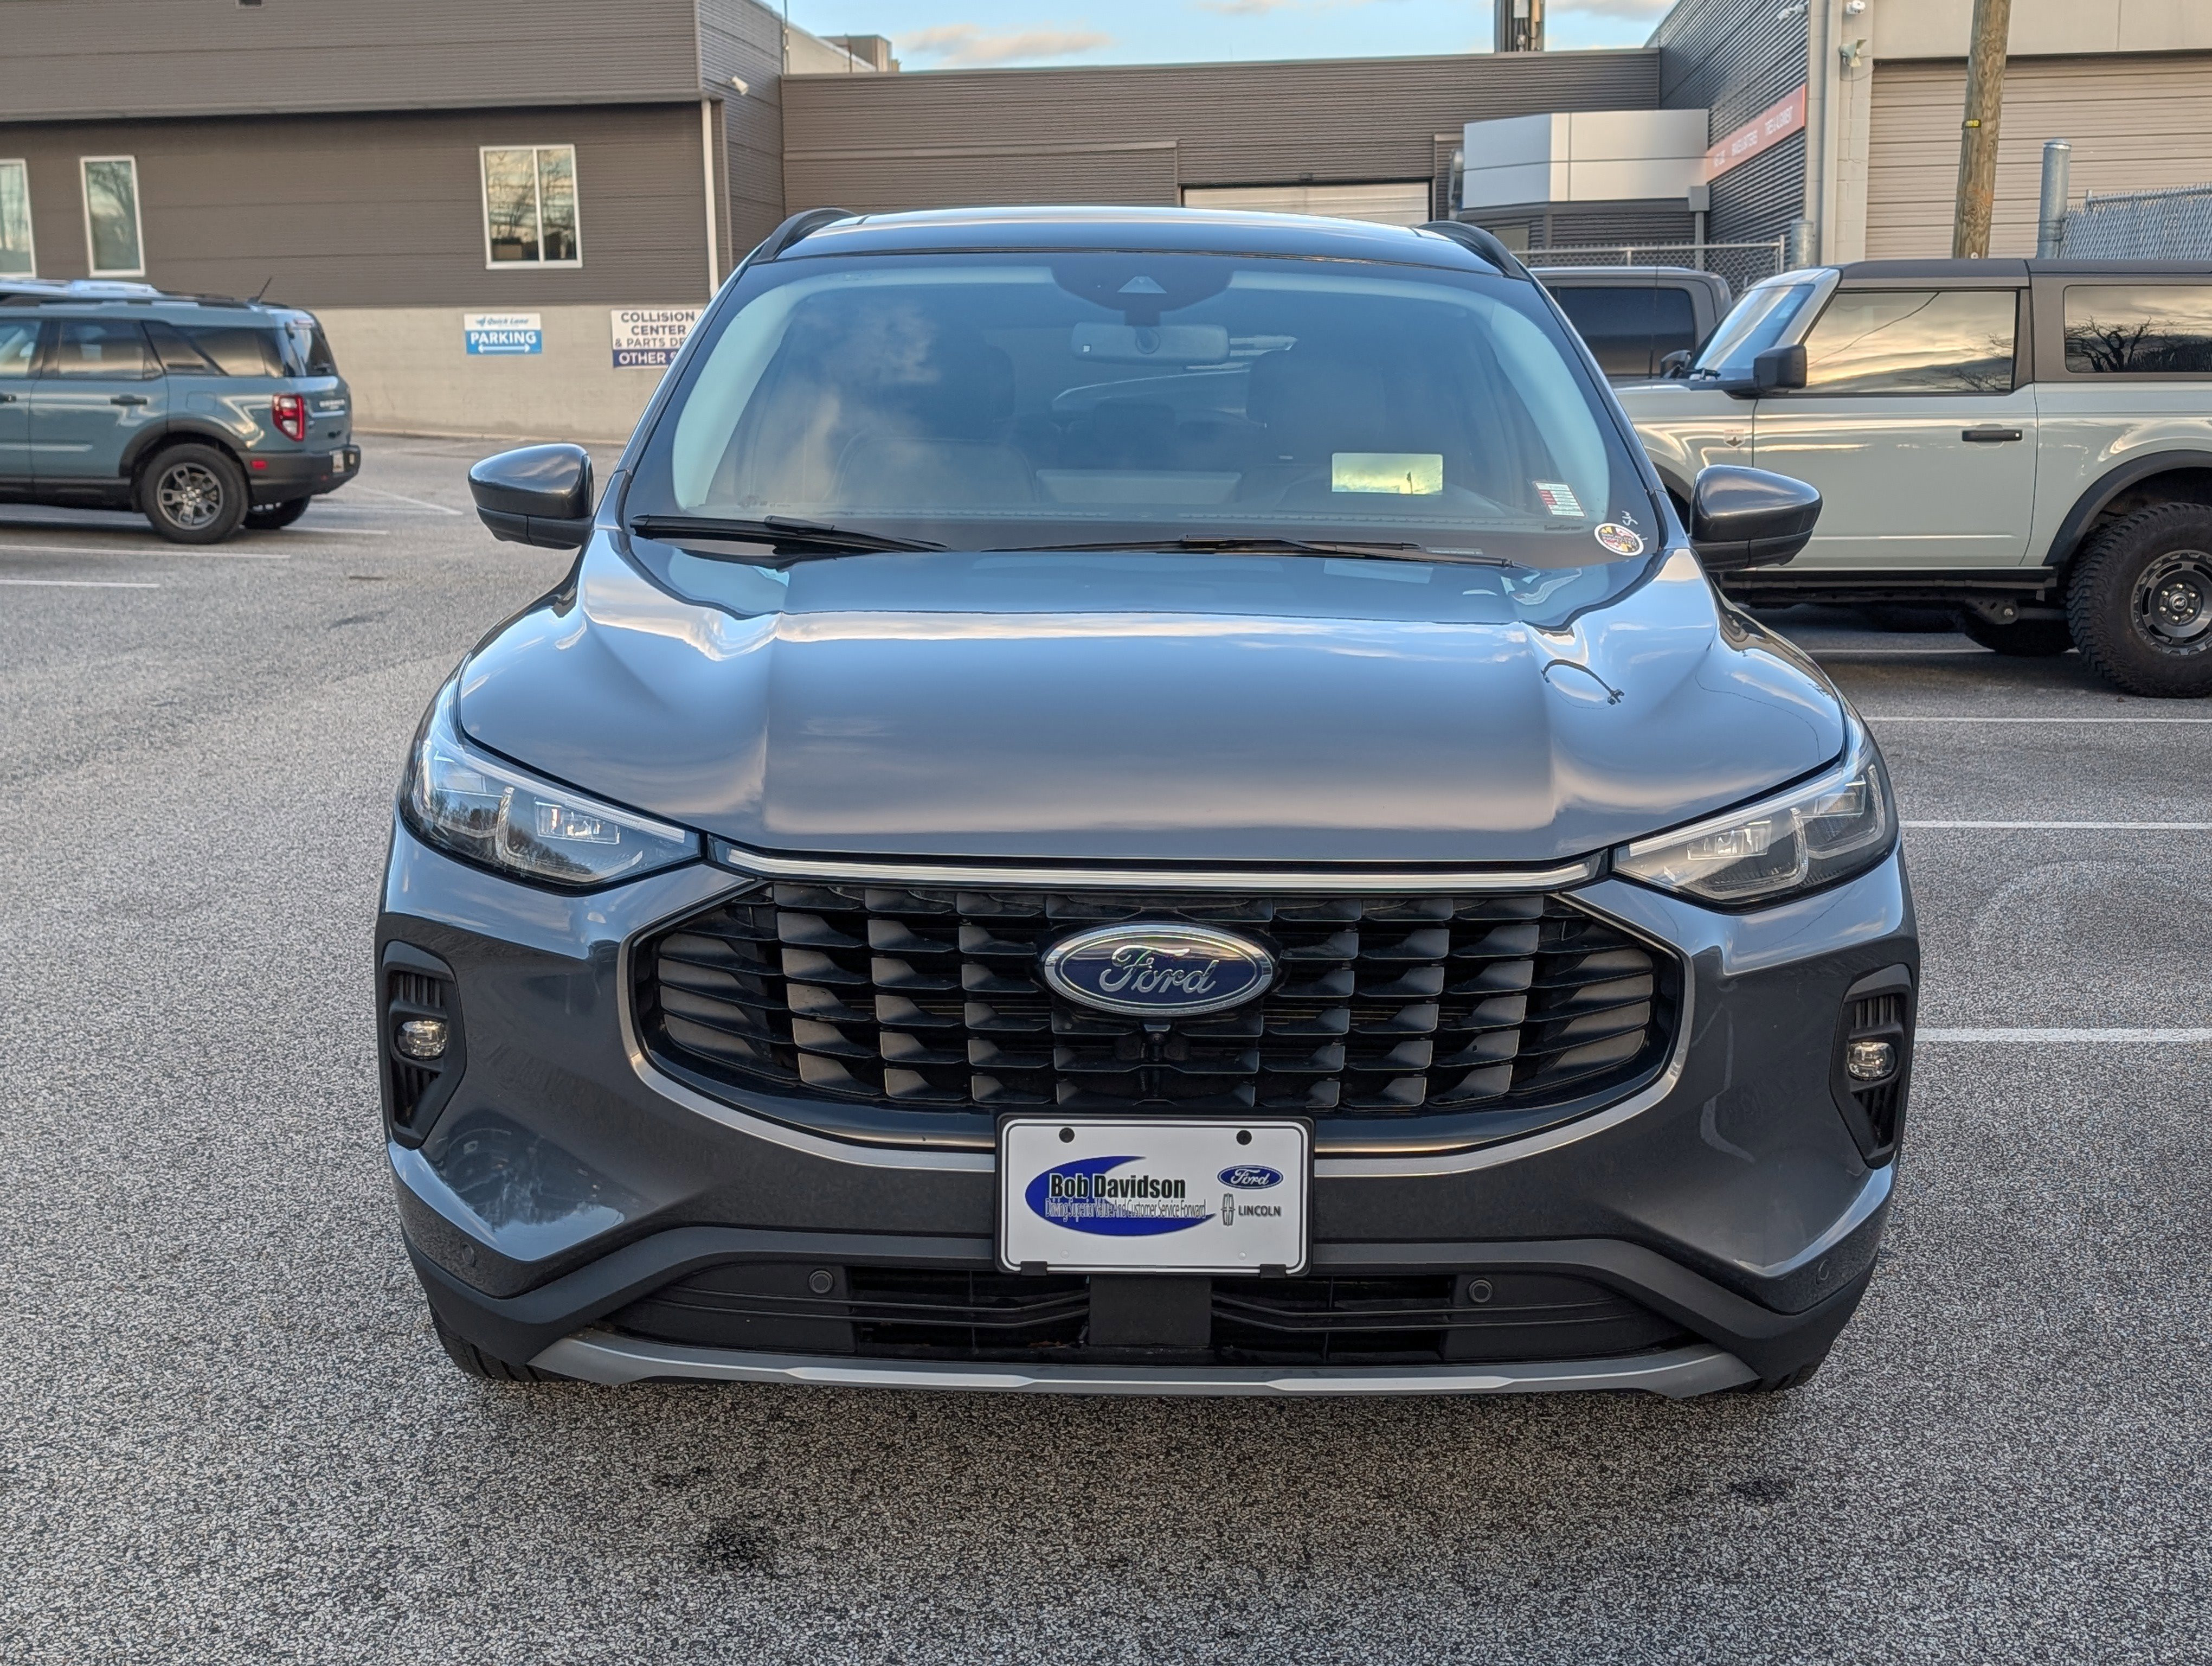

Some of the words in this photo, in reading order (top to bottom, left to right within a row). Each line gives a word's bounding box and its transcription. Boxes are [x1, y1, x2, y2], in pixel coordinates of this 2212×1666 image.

[487, 317, 508, 325] Quick
[621, 311, 695, 323] COLLISION
[631, 325, 686, 336] CENTER
[470, 331, 537, 345] PARKING
[615, 337, 622, 348] &
[627, 337, 666, 348] PARTS
[619, 352, 666, 364] OTHER
[1099, 944, 1220, 994] Ford
[1230, 1168, 1270, 1185] Ford
[1050, 1174, 1089, 1199] Bob
[1094, 1174, 1186, 1199] Davidson
[1045, 1198, 1068, 1222] Driving
[1068, 1198, 1095, 1222] Superior
[1127, 1200, 1157, 1218] Customer
[1158, 1200, 1180, 1218] Service
[1180, 1199, 1206, 1218] Forward
[1238, 1204, 1282, 1217] LINCOLN
